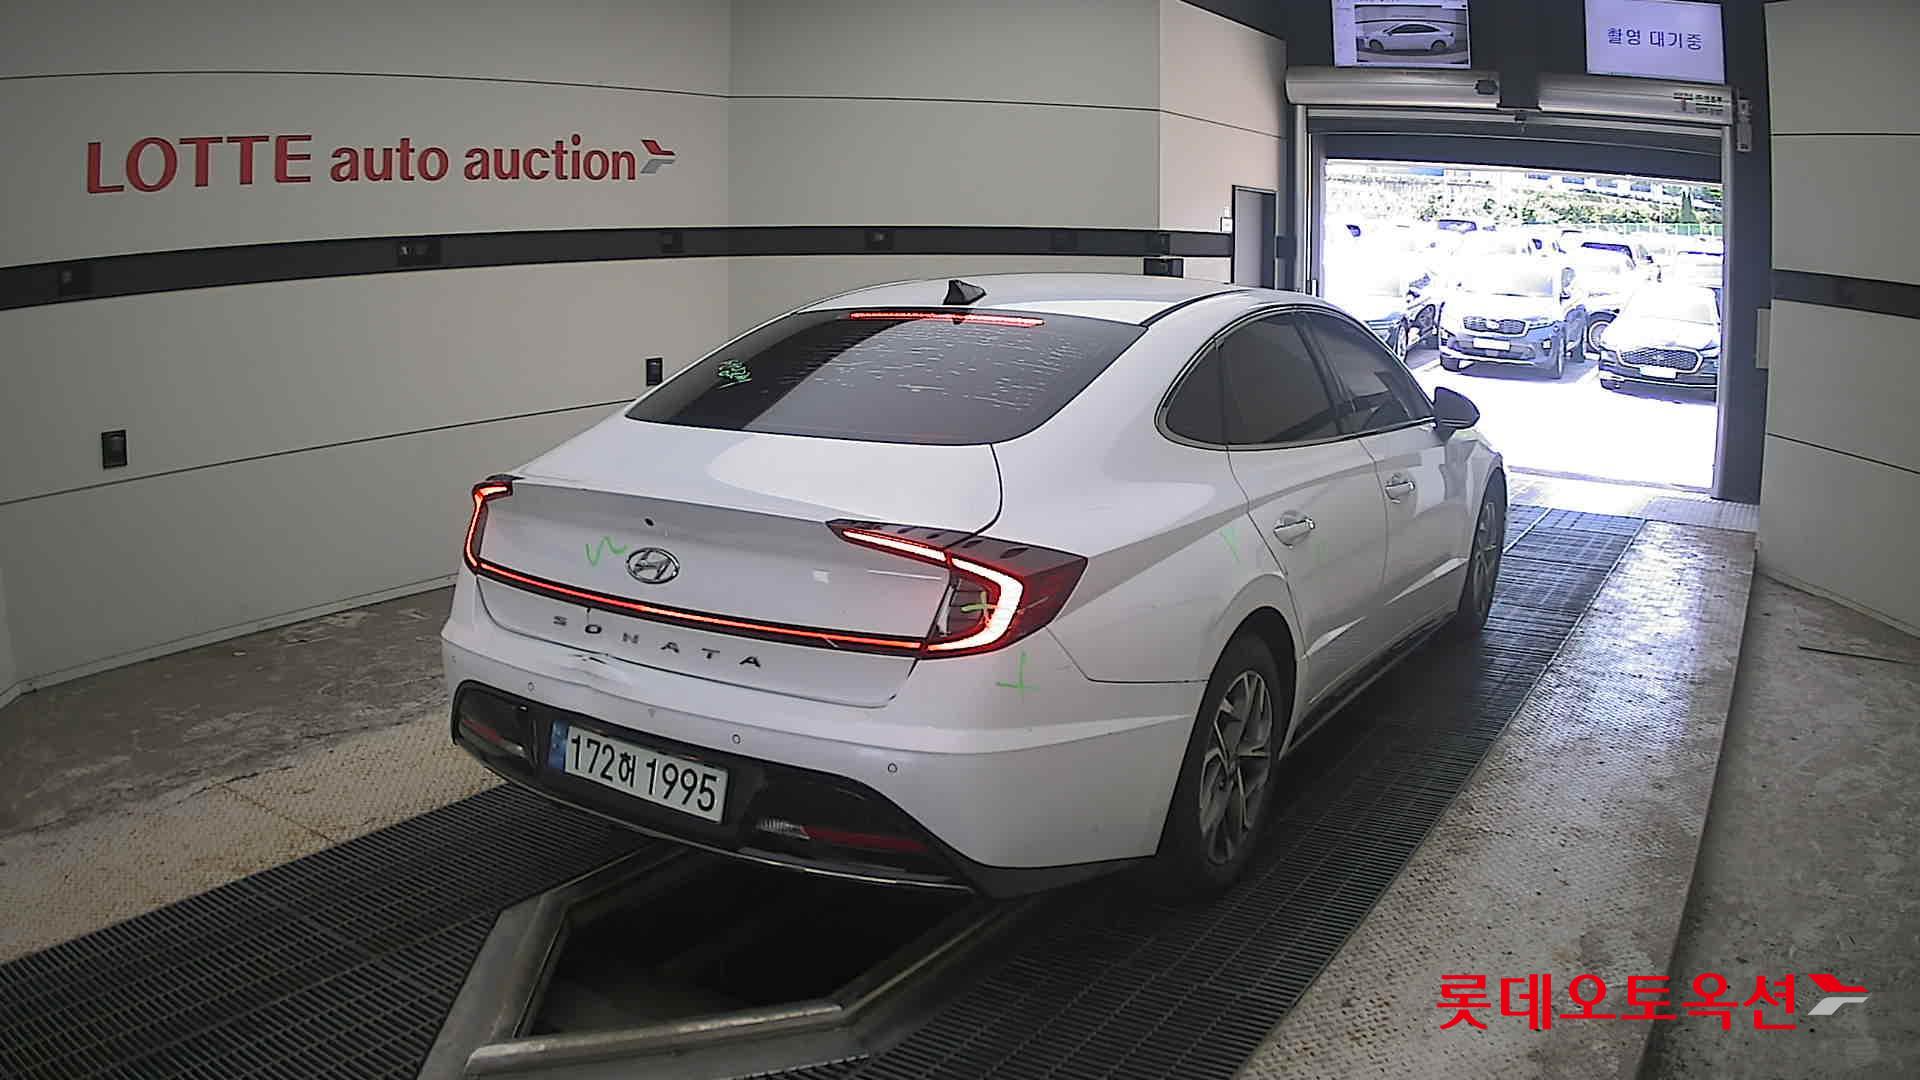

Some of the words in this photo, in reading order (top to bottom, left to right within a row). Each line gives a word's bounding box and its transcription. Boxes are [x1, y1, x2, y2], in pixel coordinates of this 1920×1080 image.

[1649, 30, 1703, 51] 대기중
[87, 134, 313, 194] LOTTE
[330, 137, 450, 182] auto
[463, 133, 638, 181] auction
[553, 615, 762, 668] SONATA
